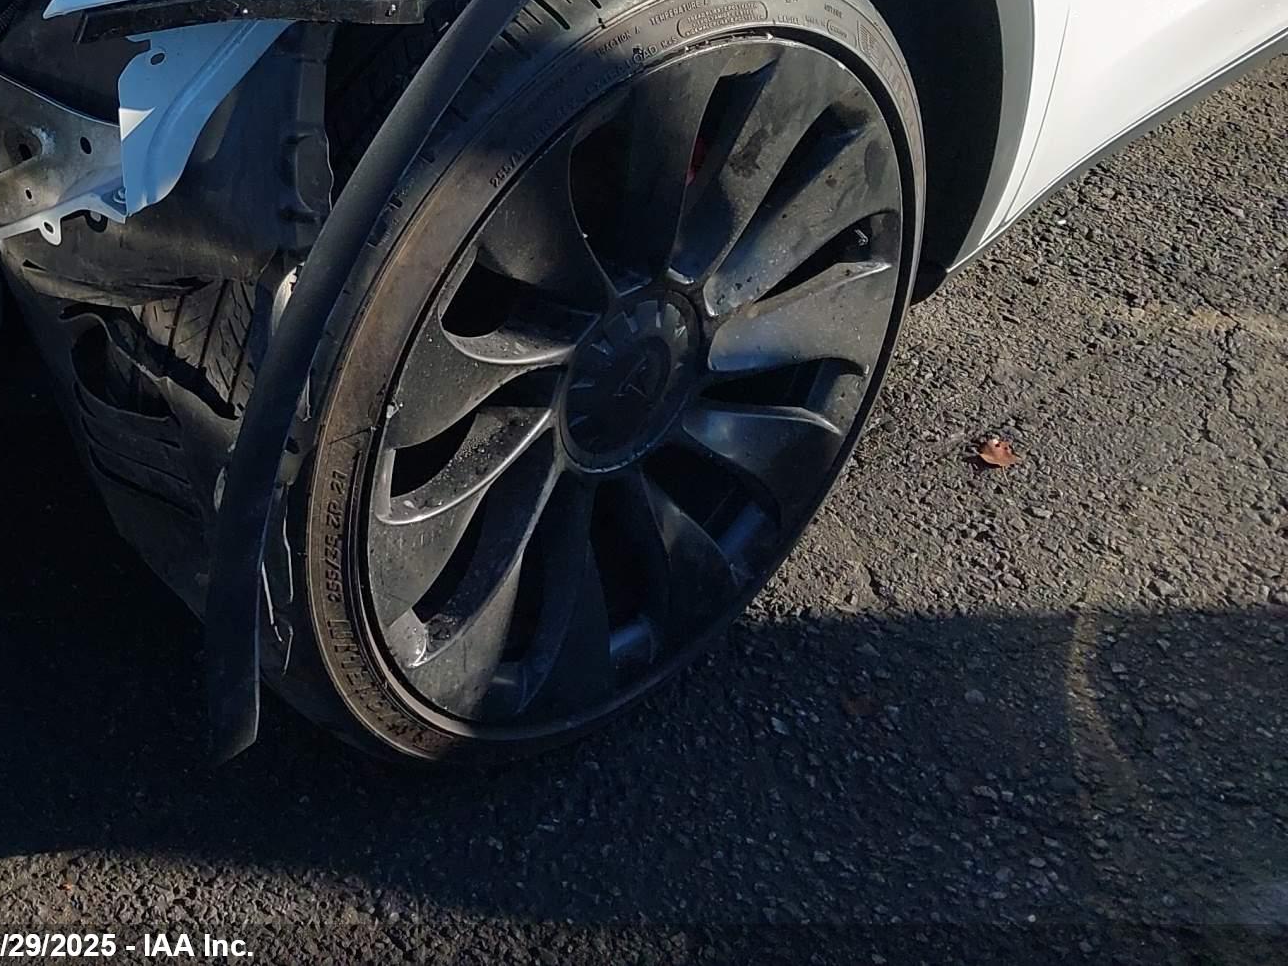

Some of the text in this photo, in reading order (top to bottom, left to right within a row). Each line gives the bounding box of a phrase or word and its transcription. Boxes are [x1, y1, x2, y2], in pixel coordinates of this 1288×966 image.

[596, 31, 632, 57] TRACTION
[649, 0, 701, 26] TEMPERATURE
[330, 470, 347, 494] 21
[324, 533, 344, 603] 255/35
